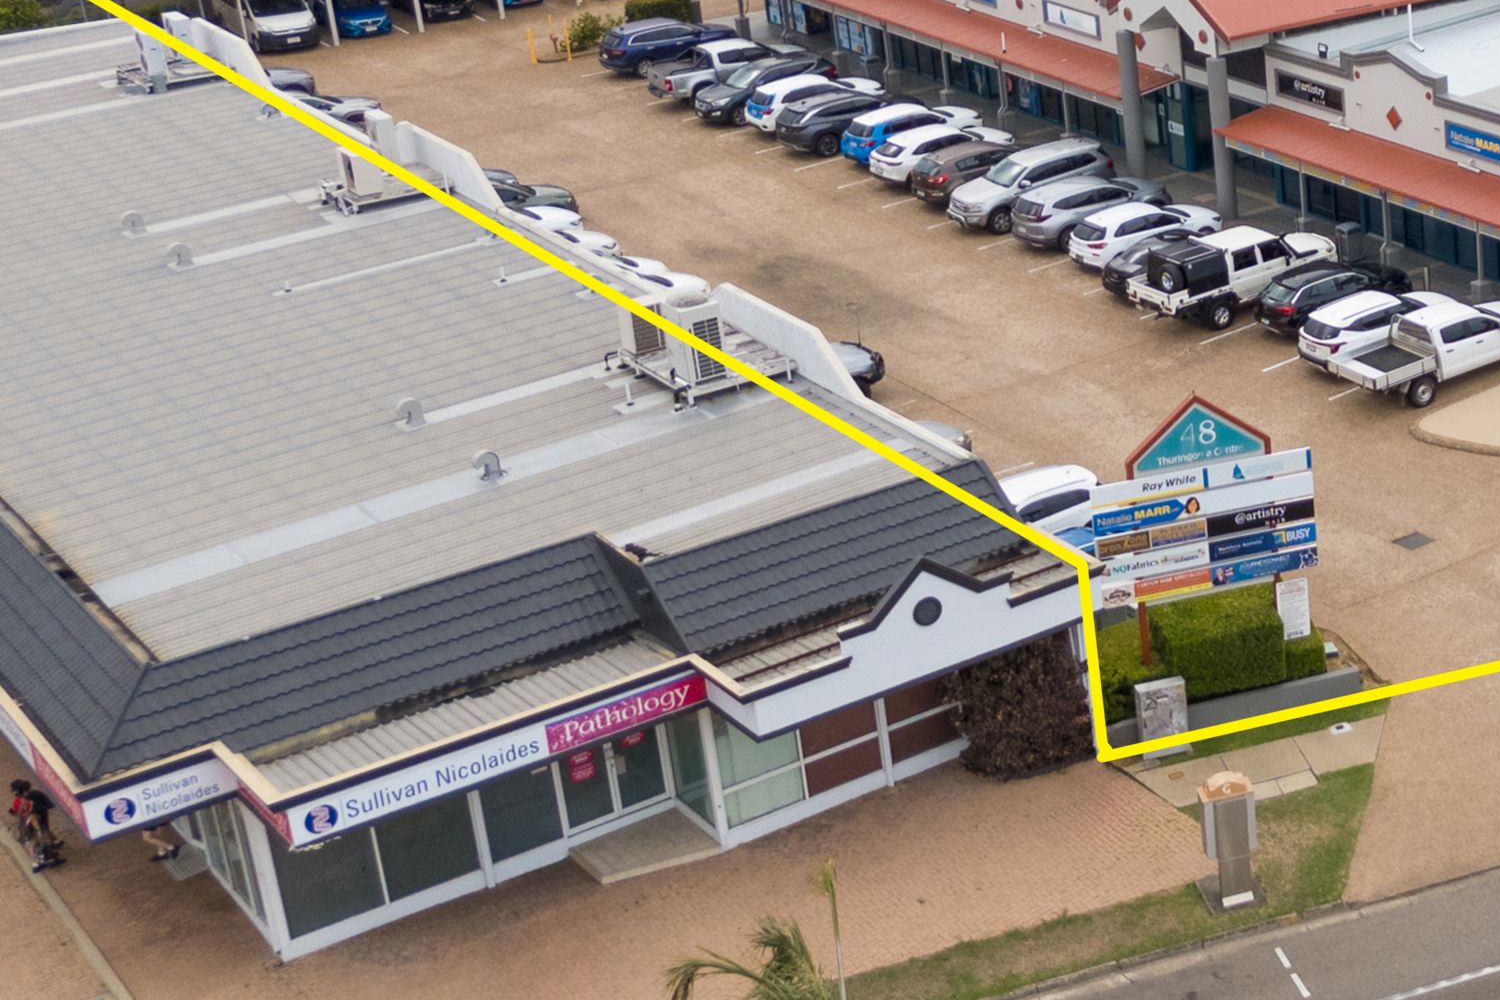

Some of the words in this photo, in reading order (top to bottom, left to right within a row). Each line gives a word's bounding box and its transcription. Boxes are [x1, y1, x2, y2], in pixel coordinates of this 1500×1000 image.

[1475, 137, 1500, 153] MARR
[1180, 419, 1217, 447] 48
[1156, 449, 1212, 466] Thuringoa
[1142, 480, 1164, 493] Ray
[1165, 474, 1197, 488] White
[1097, 513, 1132, 527] Natalie
[1133, 504, 1171, 520] MARR
[1234, 506, 1287, 525] @artistry
[1286, 527, 1311, 542] BUSY
[1112, 559, 1160, 574] NQFabrics
[563, 682, 692, 743] Pathology
[141, 773, 199, 801] Sullivan
[344, 776, 429, 819] Sullivan
[434, 738, 541, 788] Nicolaides
[145, 783, 221, 816] Nicolaides
